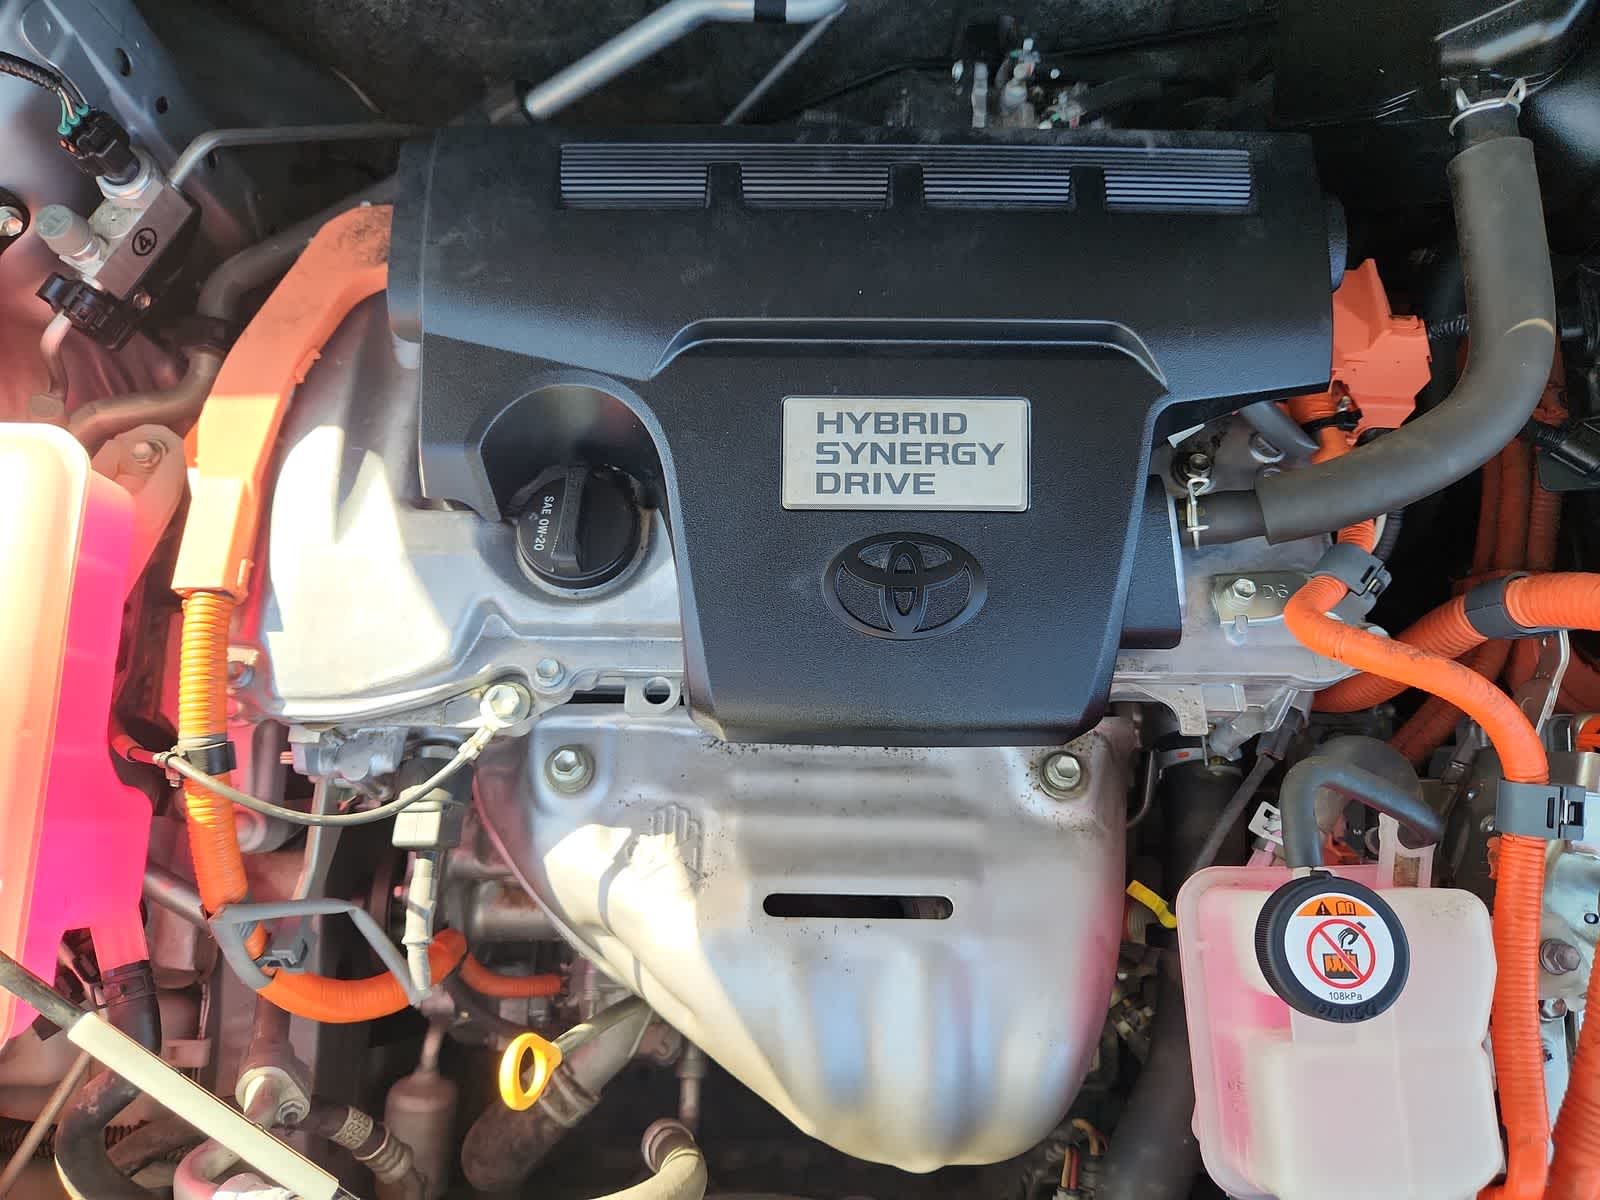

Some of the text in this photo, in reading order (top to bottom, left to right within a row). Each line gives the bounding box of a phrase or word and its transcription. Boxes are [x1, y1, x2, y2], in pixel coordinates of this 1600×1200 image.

[816, 411, 968, 435] HYBRID
[815, 441, 1005, 466] SYNERGY
[815, 472, 936, 495] DRIVE
[542, 495, 555, 515] SAE
[1328, 991, 1363, 1001] 108kPa
